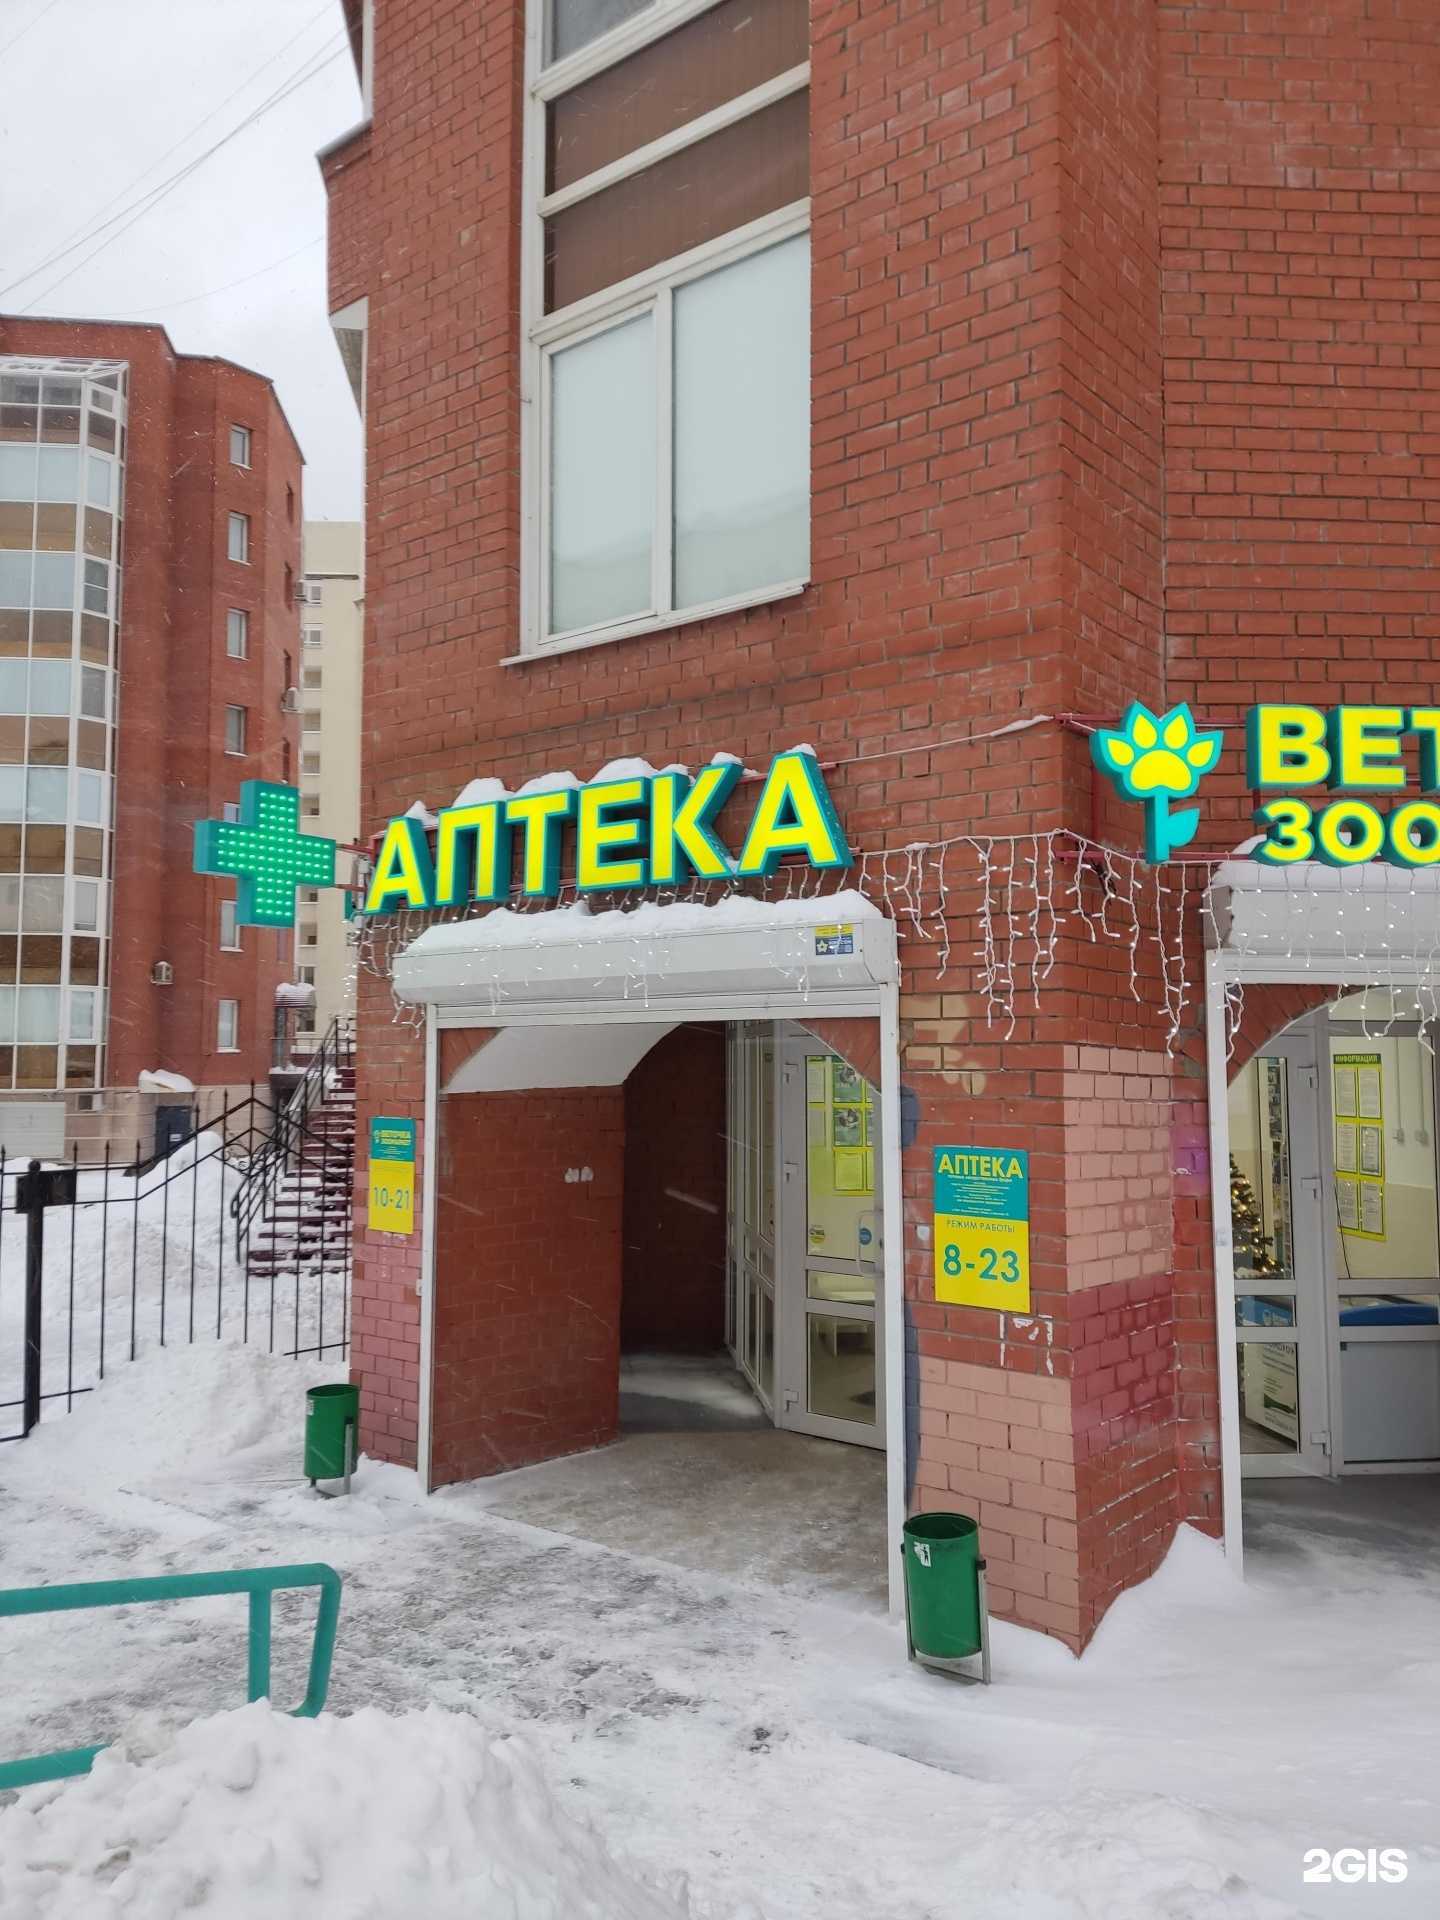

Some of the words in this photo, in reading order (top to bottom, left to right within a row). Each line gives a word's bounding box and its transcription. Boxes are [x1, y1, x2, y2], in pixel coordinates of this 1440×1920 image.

[363, 752, 852, 915] АПТЕКА
[938, 1153, 1024, 1179] АПТЕКА
[373, 1186, 410, 1210] 10-21
[946, 1219, 978, 1231] РЕЖИМ
[980, 1222, 1015, 1233] РАБОТЫ
[943, 1244, 1020, 1283] 8-23
